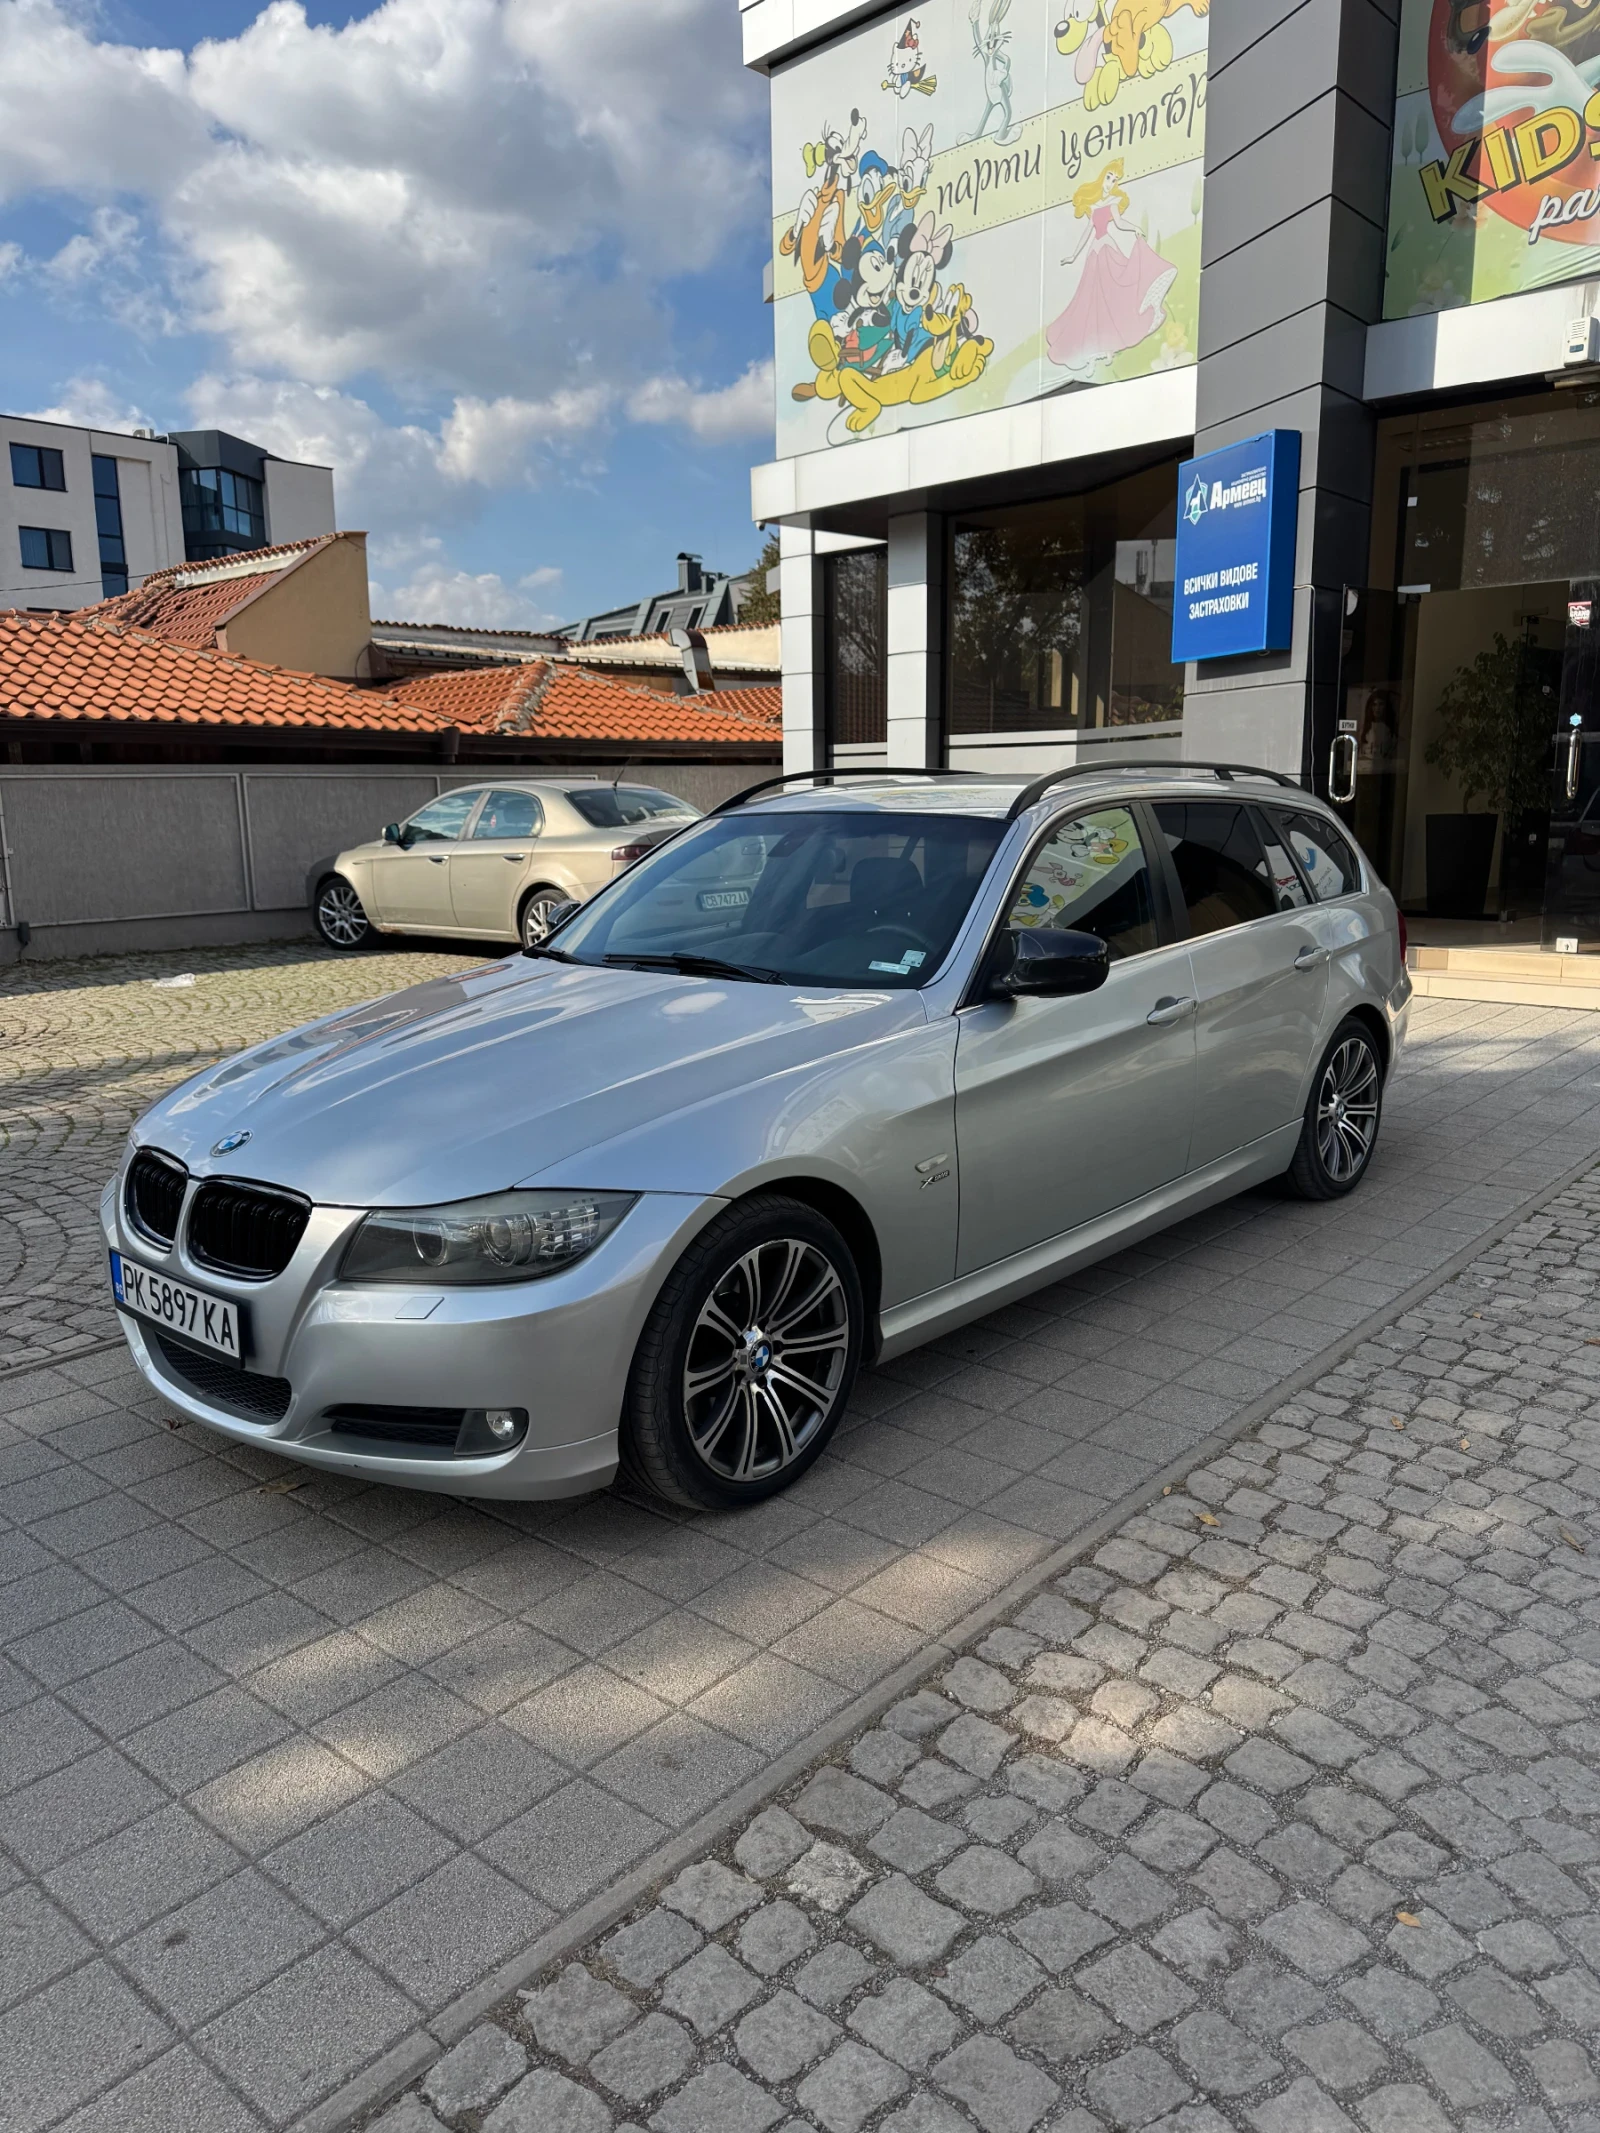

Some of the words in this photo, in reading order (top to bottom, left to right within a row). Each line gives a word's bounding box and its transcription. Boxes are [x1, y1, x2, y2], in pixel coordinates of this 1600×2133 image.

[937, 143, 1042, 216] парти
[1060, 72, 1207, 178] център
[1528, 185, 1600, 245] pa
[1210, 477, 1267, 510] Армеец
[1183, 571, 1219, 596] ВСИЧКИ
[1220, 562, 1259, 587] ВИДОВЕ
[1188, 591, 1250, 620] ЗАСТРАХОВКИ
[115, 1281, 124, 1296] BG
[149, 1276, 198, 1332] 5897
